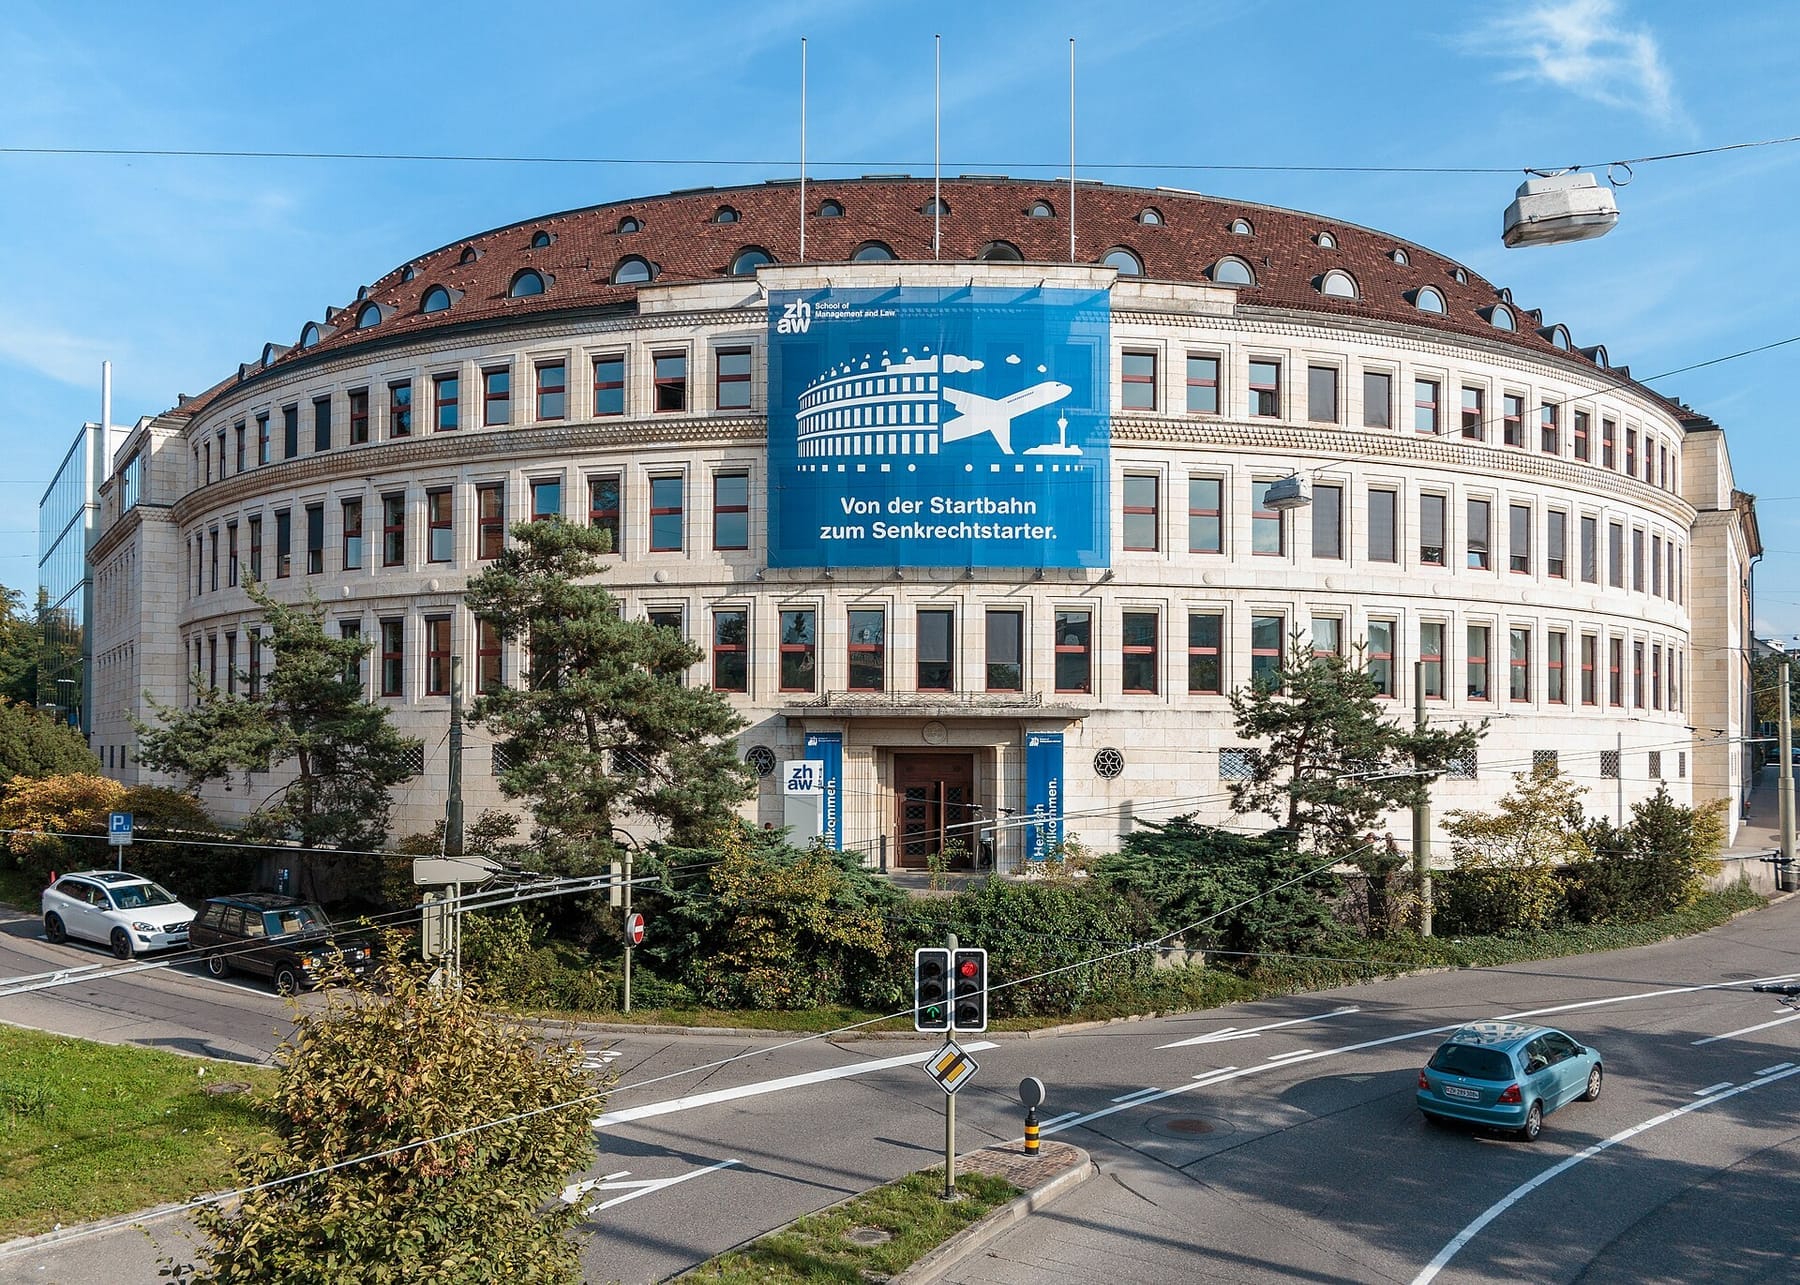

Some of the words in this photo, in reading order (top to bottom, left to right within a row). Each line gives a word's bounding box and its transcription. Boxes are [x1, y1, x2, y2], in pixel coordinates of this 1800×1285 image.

[783, 298, 811, 318] zh
[815, 302, 840, 310] School
[841, 302, 850, 310] of
[815, 310, 863, 319] Management
[864, 309, 878, 317] and
[879, 309, 896, 317] Law
[777, 318, 811, 334] aw
[841, 497, 880, 514] Von
[888, 497, 924, 514] der
[931, 497, 1037, 514] Startbahn
[820, 526, 865, 540] zum
[872, 521, 1058, 540] Senkrechtstarter.
[792, 764, 813, 779] zh
[788, 779, 813, 791] aw
[113, 815, 124, 831] P
